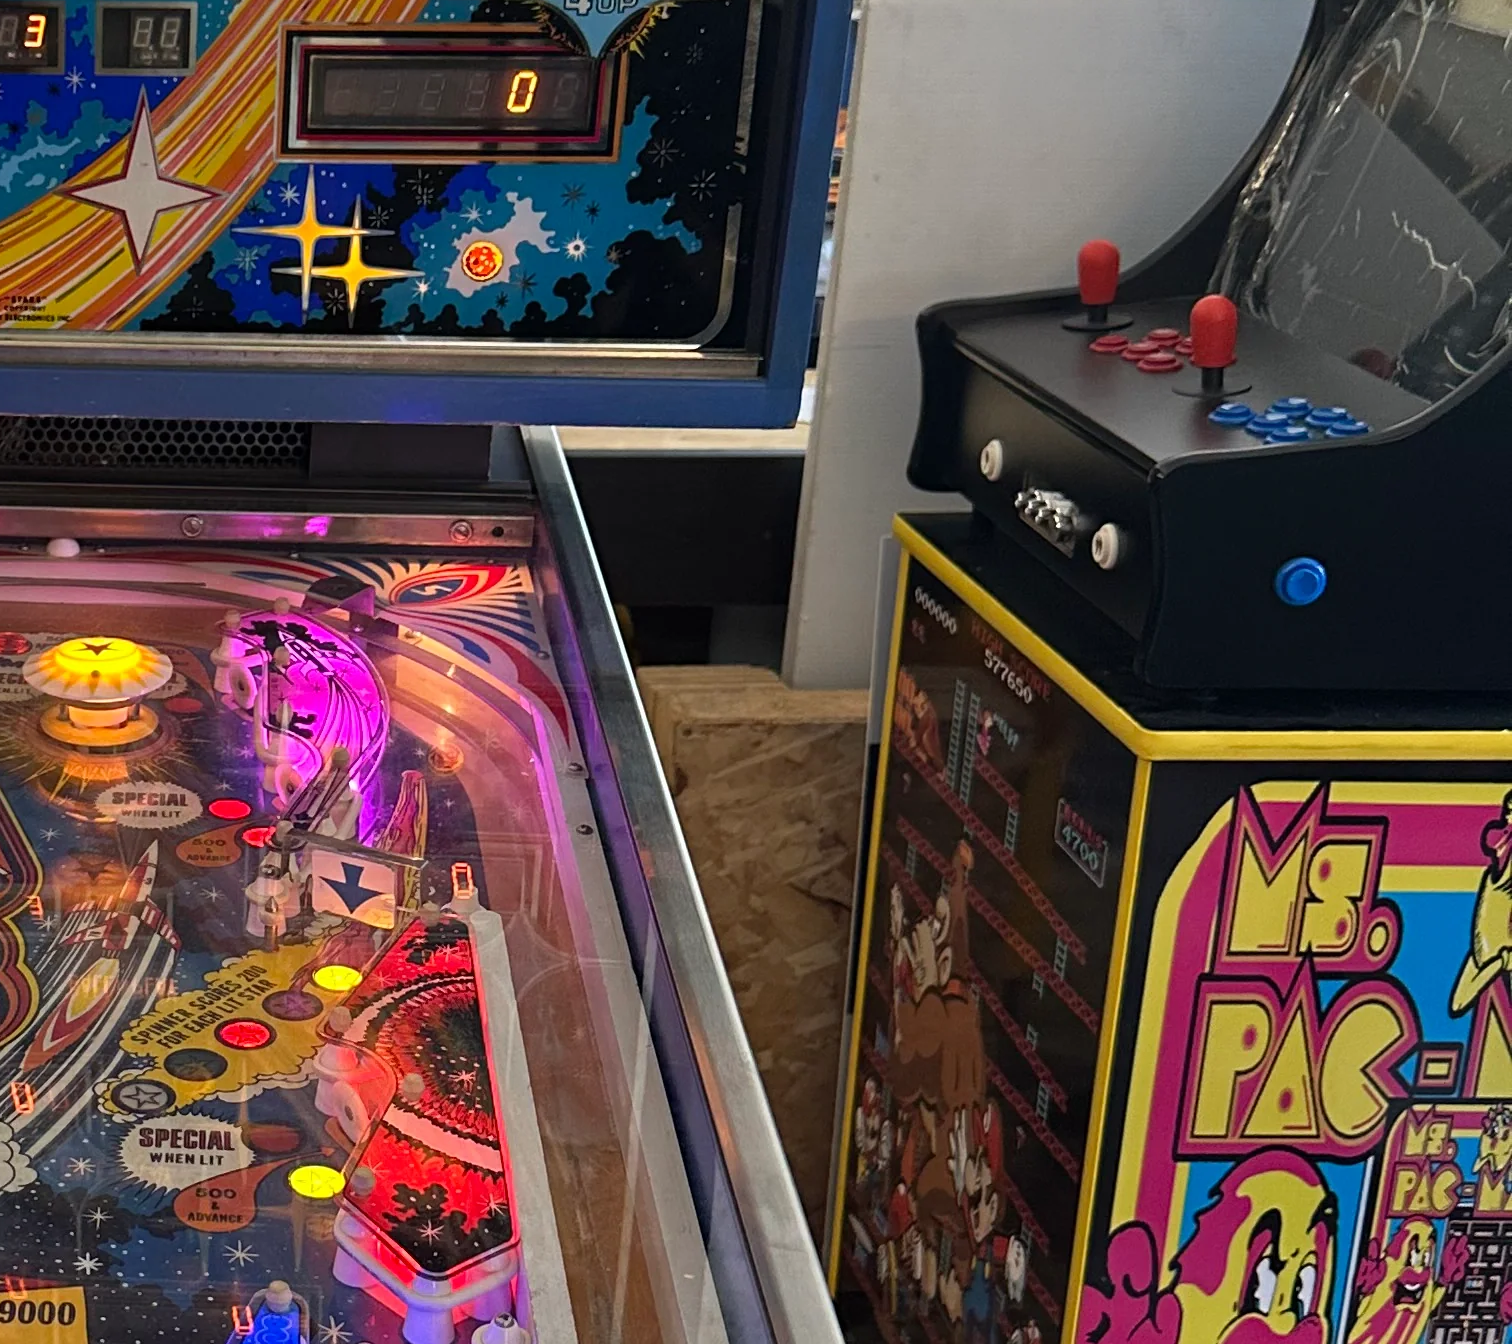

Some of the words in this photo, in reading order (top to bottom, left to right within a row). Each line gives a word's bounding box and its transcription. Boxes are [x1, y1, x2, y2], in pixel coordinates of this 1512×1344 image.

[24, 15, 47, 47] 3
[507, 70, 538, 113] 0
[112, 792, 189, 807] SPECIAL
[121, 810, 157, 818] WHEN
[162, 810, 181, 818] LIT
[130, 1008, 194, 1045] SPINNER
[189, 980, 240, 1011] SCORES
[236, 965, 268, 983] 200
[156, 1028, 191, 1050] FOR
[190, 1009, 224, 1034] EACH
[216, 997, 245, 1016] LIT
[239, 979, 278, 1002] STAR
[139, 1127, 235, 1152] SPECIAL
[150, 1152, 194, 1165] WHEN
[199, 1153, 225, 1167] LIT
[195, 1188, 238, 1200] 500
[187, 1212, 244, 1224] ADVANCE
